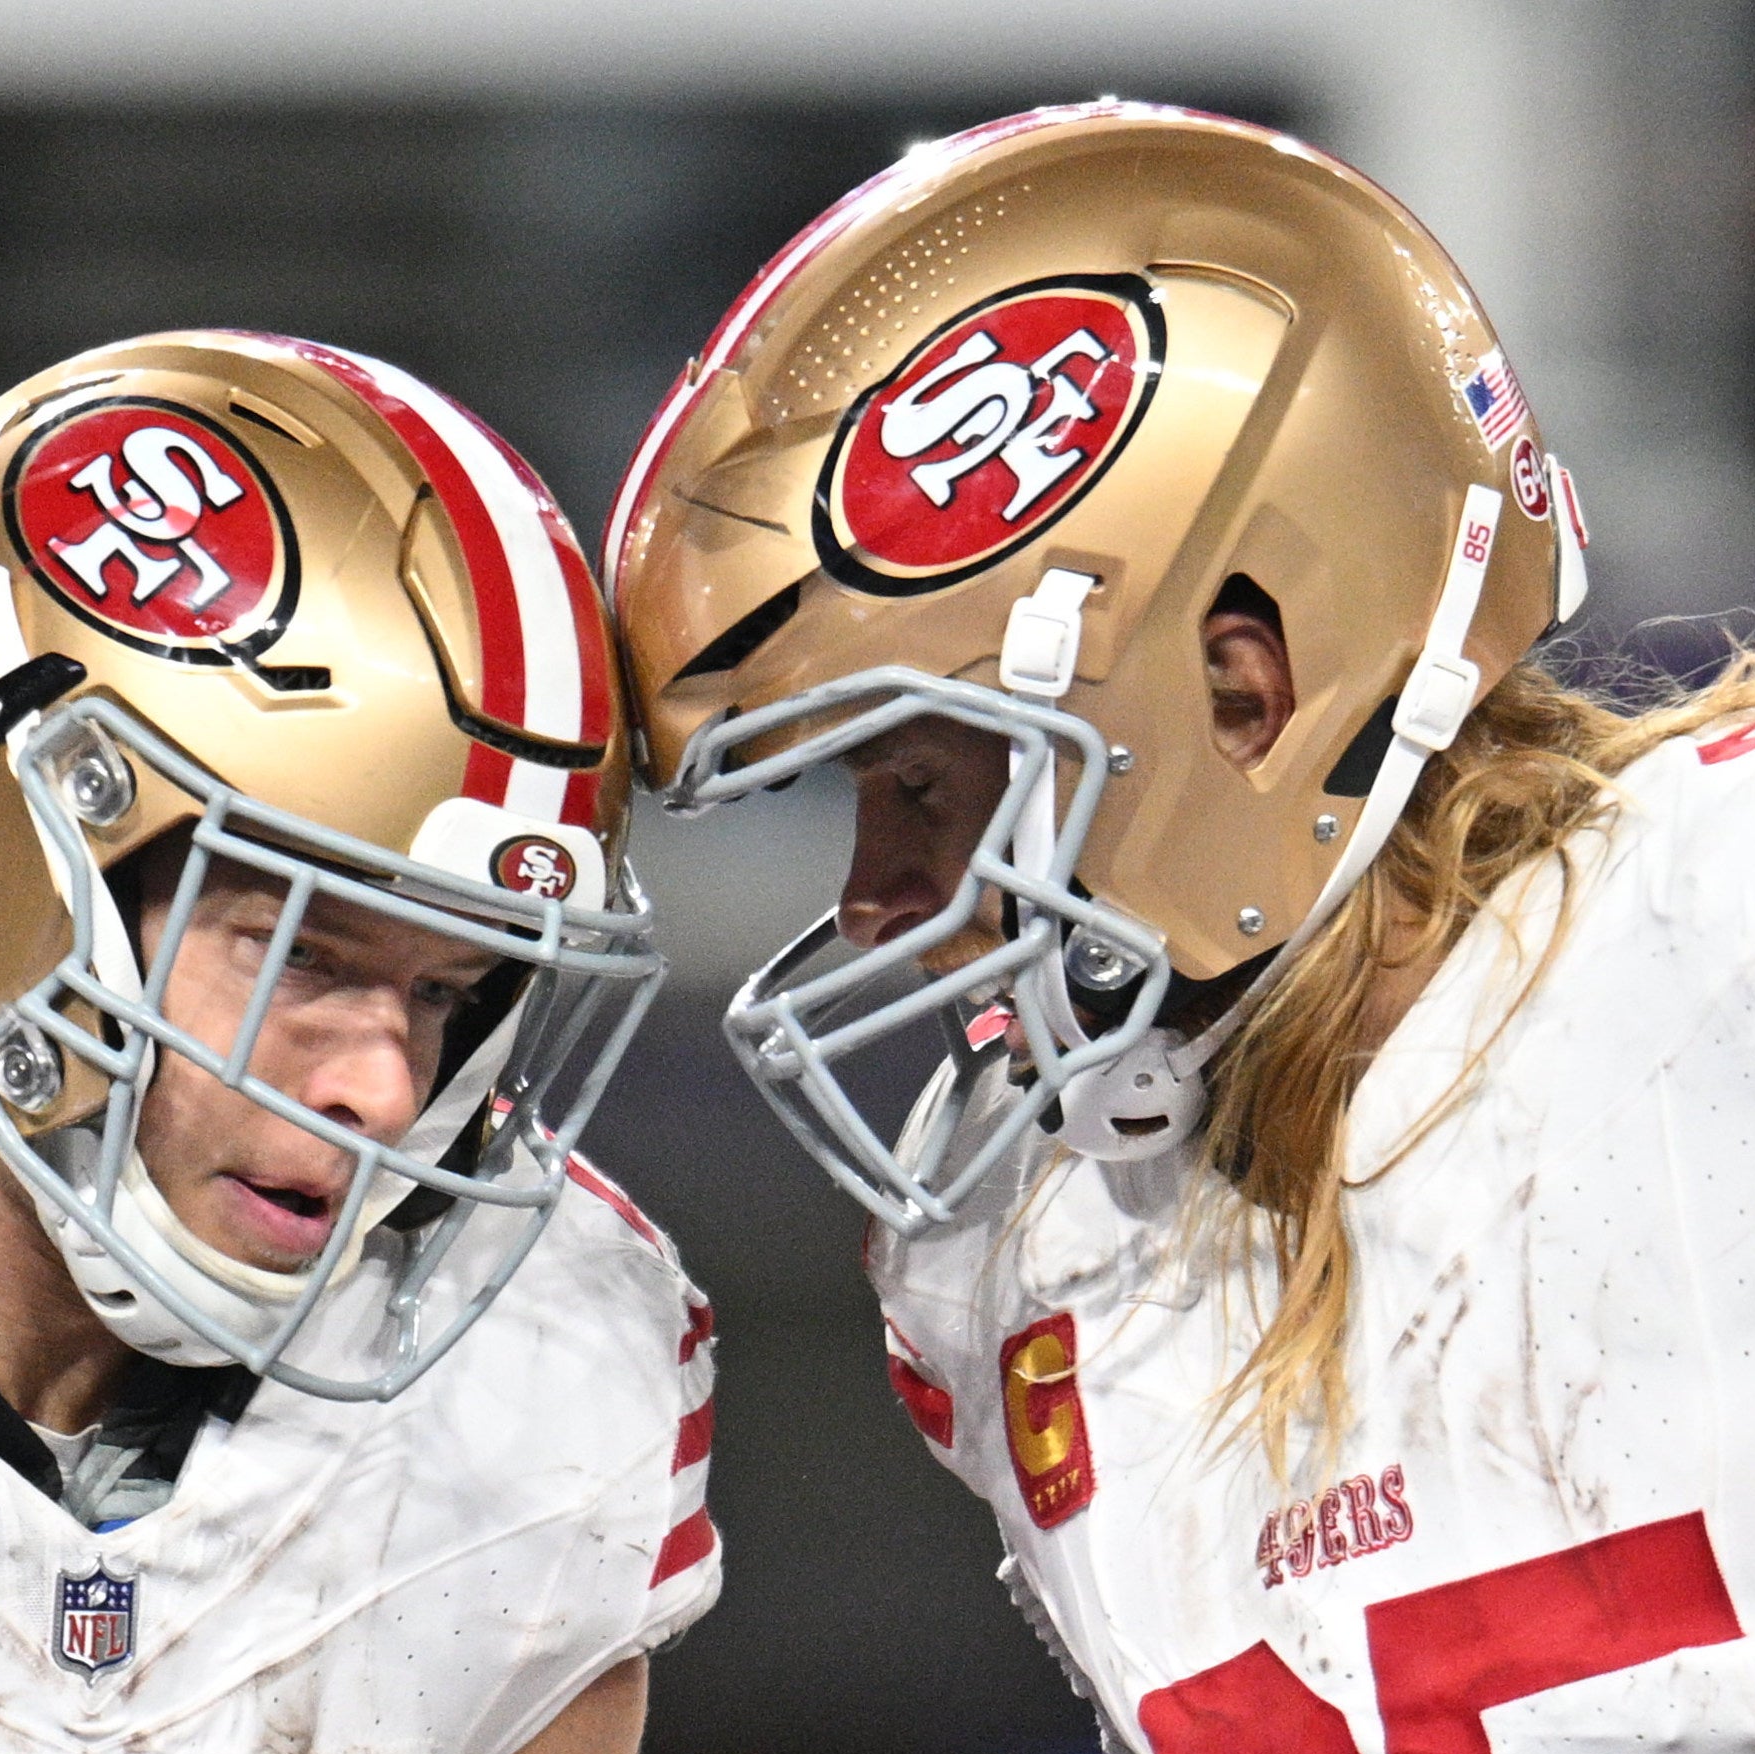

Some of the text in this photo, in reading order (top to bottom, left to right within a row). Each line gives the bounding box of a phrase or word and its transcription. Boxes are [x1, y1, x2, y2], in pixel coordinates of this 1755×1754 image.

[880, 327, 1114, 522] SF
[47, 427, 244, 614] SF
[1463, 520, 1491, 563] 85
[517, 844, 567, 899] SF
[1007, 1333, 1074, 1476] C
[1256, 1463, 1413, 1590] 49ERS
[67, 1612, 124, 1660] NFL
